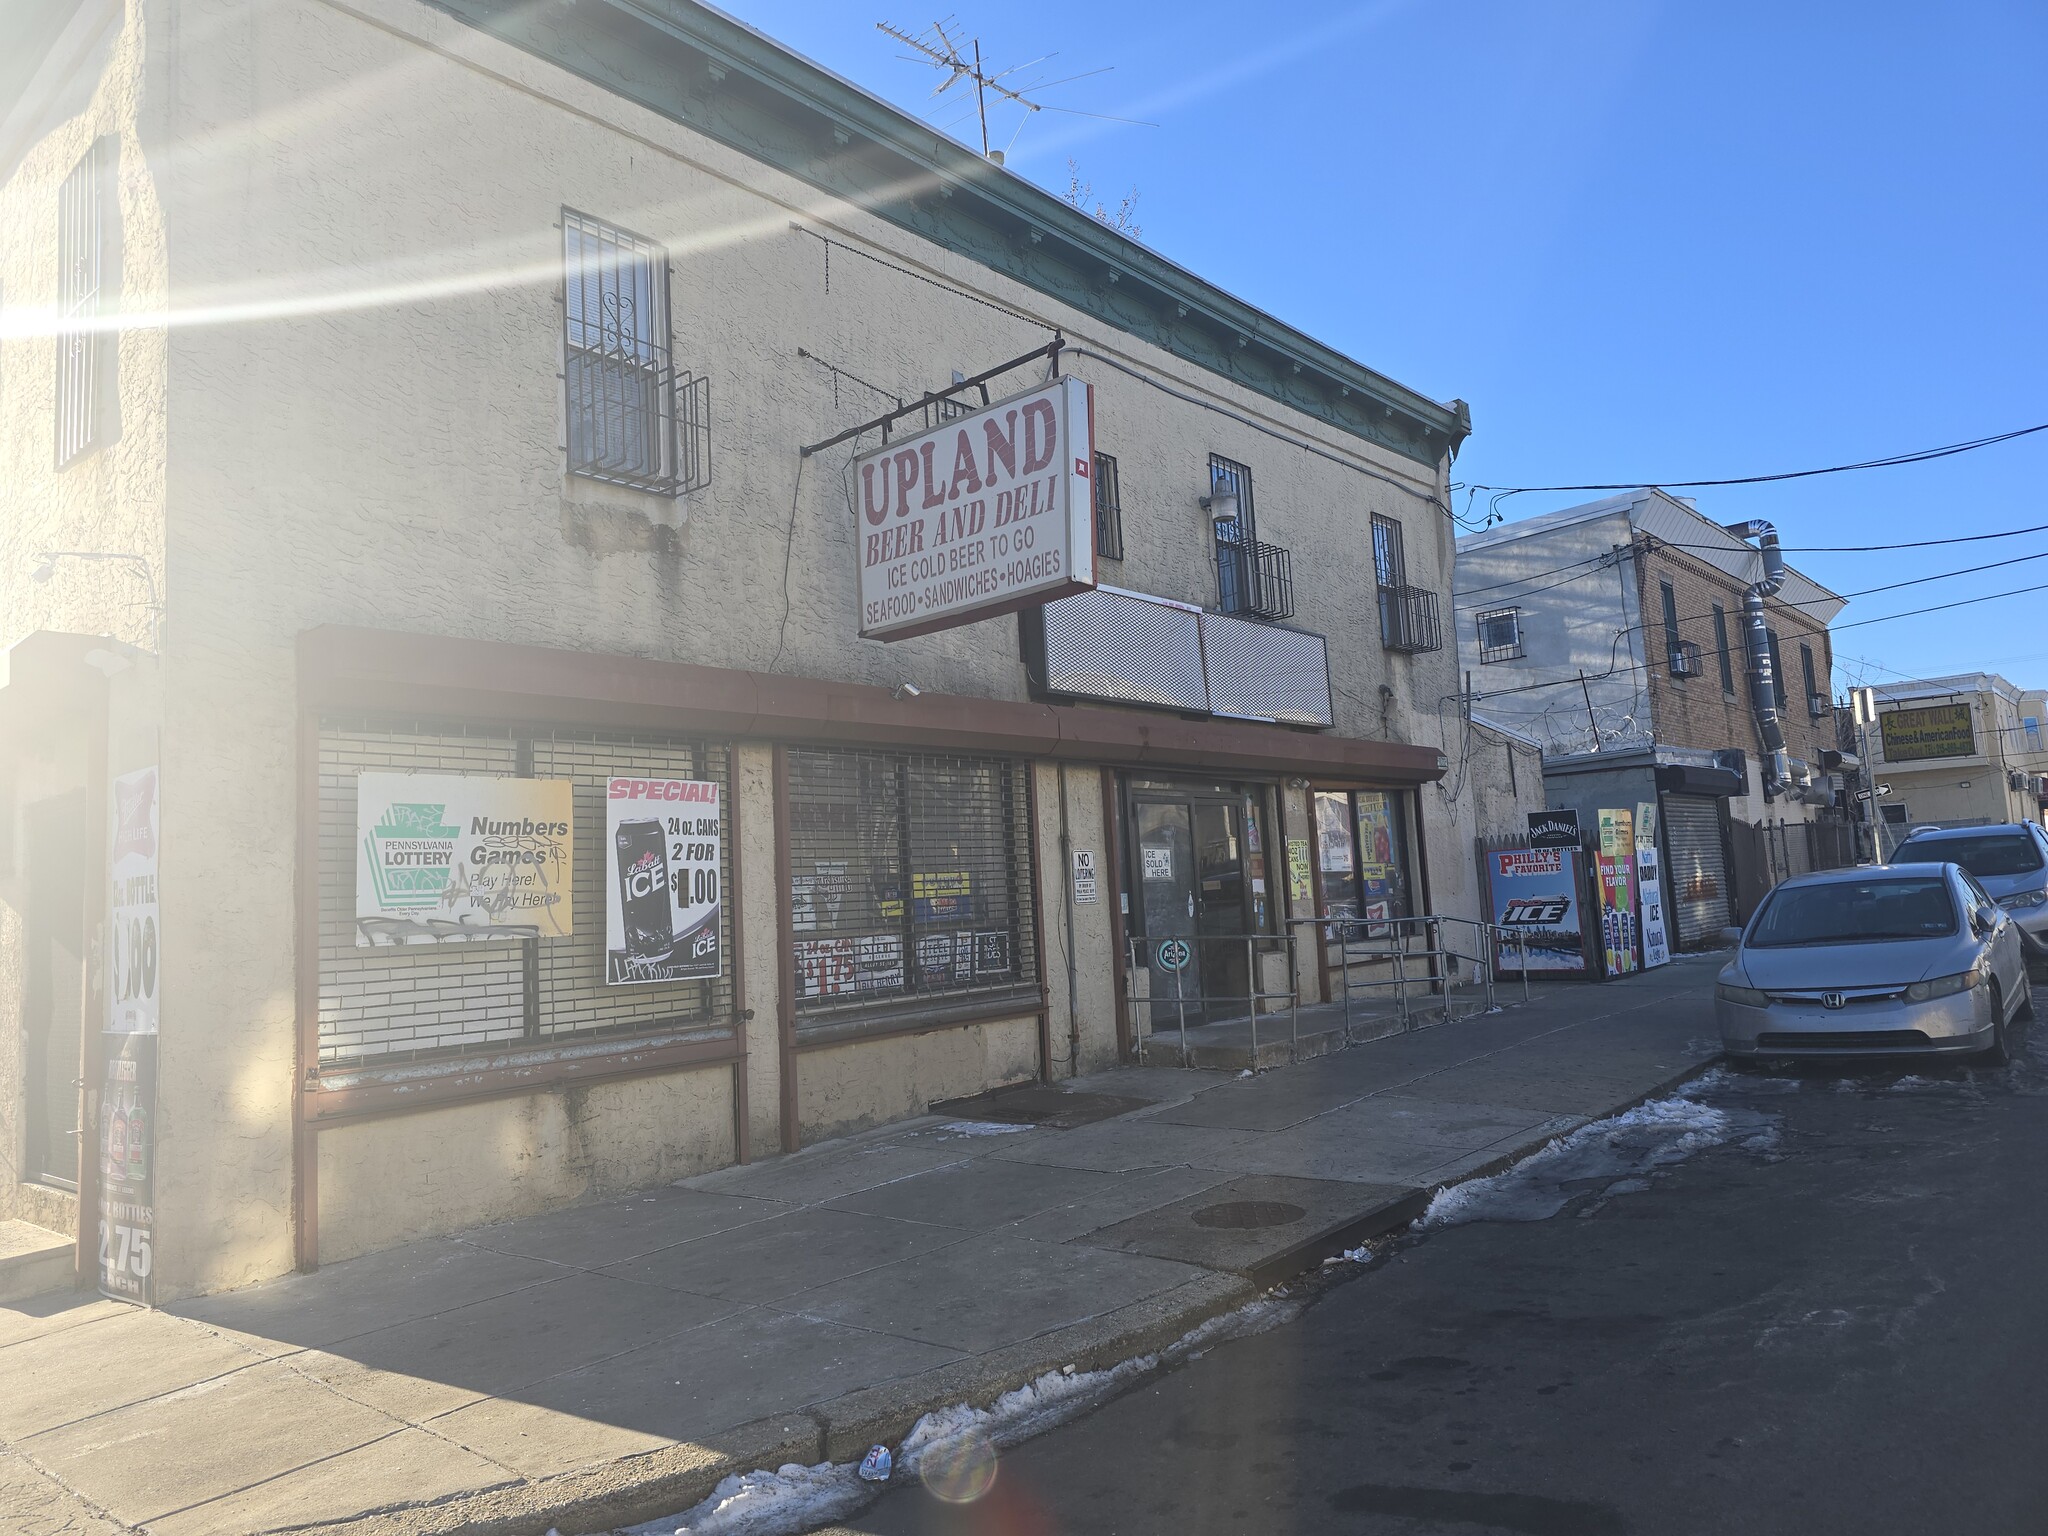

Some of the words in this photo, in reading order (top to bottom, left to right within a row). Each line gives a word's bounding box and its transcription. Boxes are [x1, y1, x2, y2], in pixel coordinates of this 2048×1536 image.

[862, 398, 1056, 526] UPLAND
[865, 518, 925, 568] BEER
[932, 499, 986, 548] AND
[994, 474, 1058, 529] DELI
[887, 566, 907, 590] ICE
[911, 552, 946, 583] COLD
[950, 540, 985, 572] BEER
[989, 533, 1009, 558] TO
[1013, 525, 1035, 552] GO
[1897, 711, 1927, 729] GREAT
[1928, 709, 1955, 725] WALL
[1886, 732, 1914, 746] Chinese
[608, 779, 718, 804] SPECIAL!
[133, 826, 149, 841] LIFE
[471, 817, 568, 836] Numbers
[668, 817, 680, 836] 24
[696, 818, 719, 837] CANS
[1530, 823, 1549, 839] JACK
[1547, 820, 1578, 836] DANIEL'S
[385, 840, 453, 850] PENNSYLVANIA
[672, 843, 684, 861] 2
[686, 843, 715, 861] FOR
[384, 852, 453, 866] LOTTERY
[470, 845, 547, 865] Games
[1078, 853, 1090, 867] NO
[1146, 851, 1156, 859] ICE
[1146, 860, 1163, 868] SOLD
[1499, 852, 1561, 874] PHILLY'S
[627, 855, 661, 877] Labatt
[1152, 869, 1169, 877] HERE
[1515, 864, 1562, 874] FAVORITE
[1600, 865, 1614, 876] FIND
[1615, 864, 1631, 875] YOUR
[1639, 864, 1658, 882] DADDY
[624, 863, 666, 902] ICE
[670, 868, 717, 908] $.00
[1606, 876, 1627, 887] FLAVOR
[1642, 886, 1659, 905] Natural
[1507, 905, 1564, 921] ICE
[1649, 904, 1659, 922] ICE
[692, 936, 717, 959] ICE
[1646, 928, 1664, 949] Natural
[1164, 950, 1186, 959] Arizna
[113, 1201, 153, 1225] BOTTLES
[101, 1272, 139, 1295] EACH
